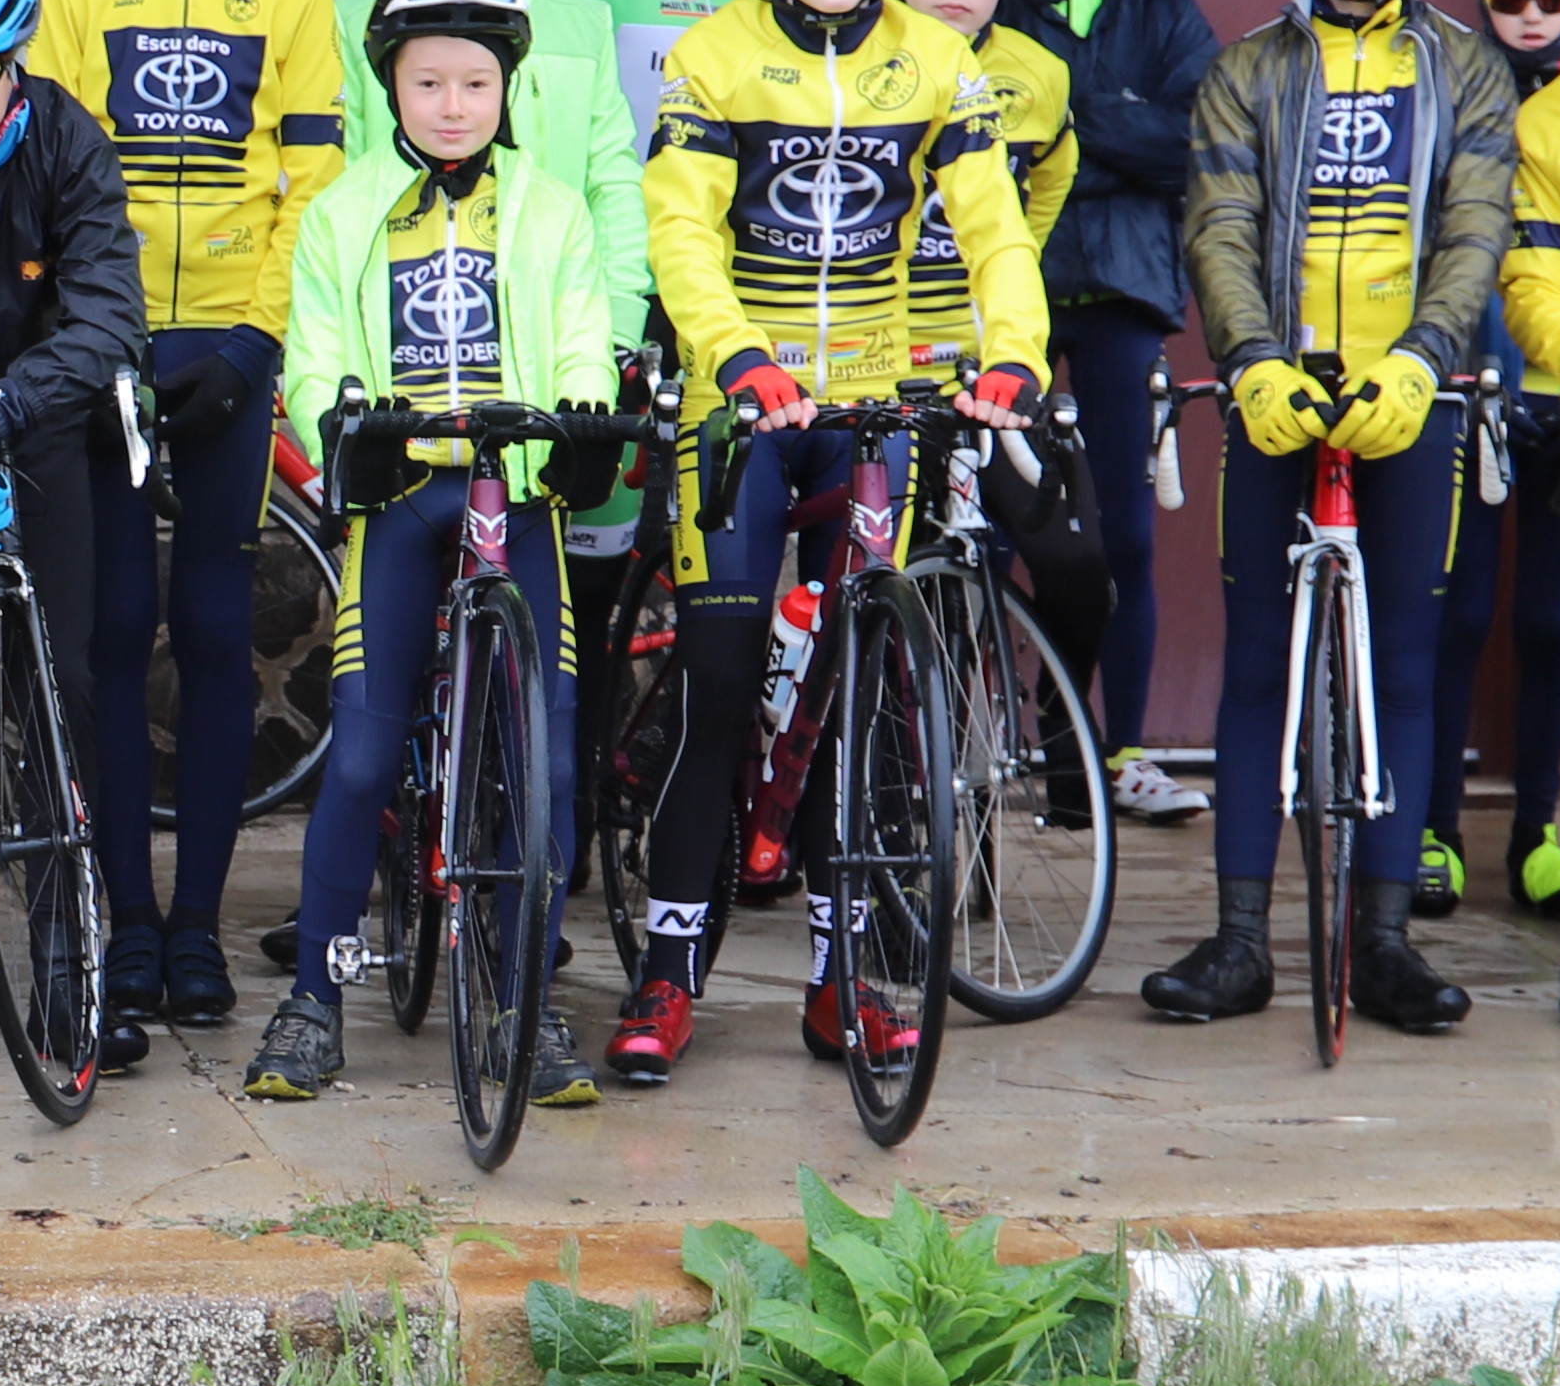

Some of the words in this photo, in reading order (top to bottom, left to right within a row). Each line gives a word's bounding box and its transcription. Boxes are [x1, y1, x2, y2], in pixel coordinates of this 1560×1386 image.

[136, 34, 231, 56] Escudero
[133, 111, 230, 134] TOYOTA
[768, 137, 899, 167] TOYOTA
[1314, 163, 1390, 185] OYOTA
[230, 227, 254, 245] ZA
[749, 223, 893, 259] ESCUDERO
[207, 243, 256, 259] laprade
[393, 341, 500, 366] ESCUDER
[864, 330, 894, 357] ZA
[826, 357, 896, 380] laprade
[704, 595, 724, 605] Club
